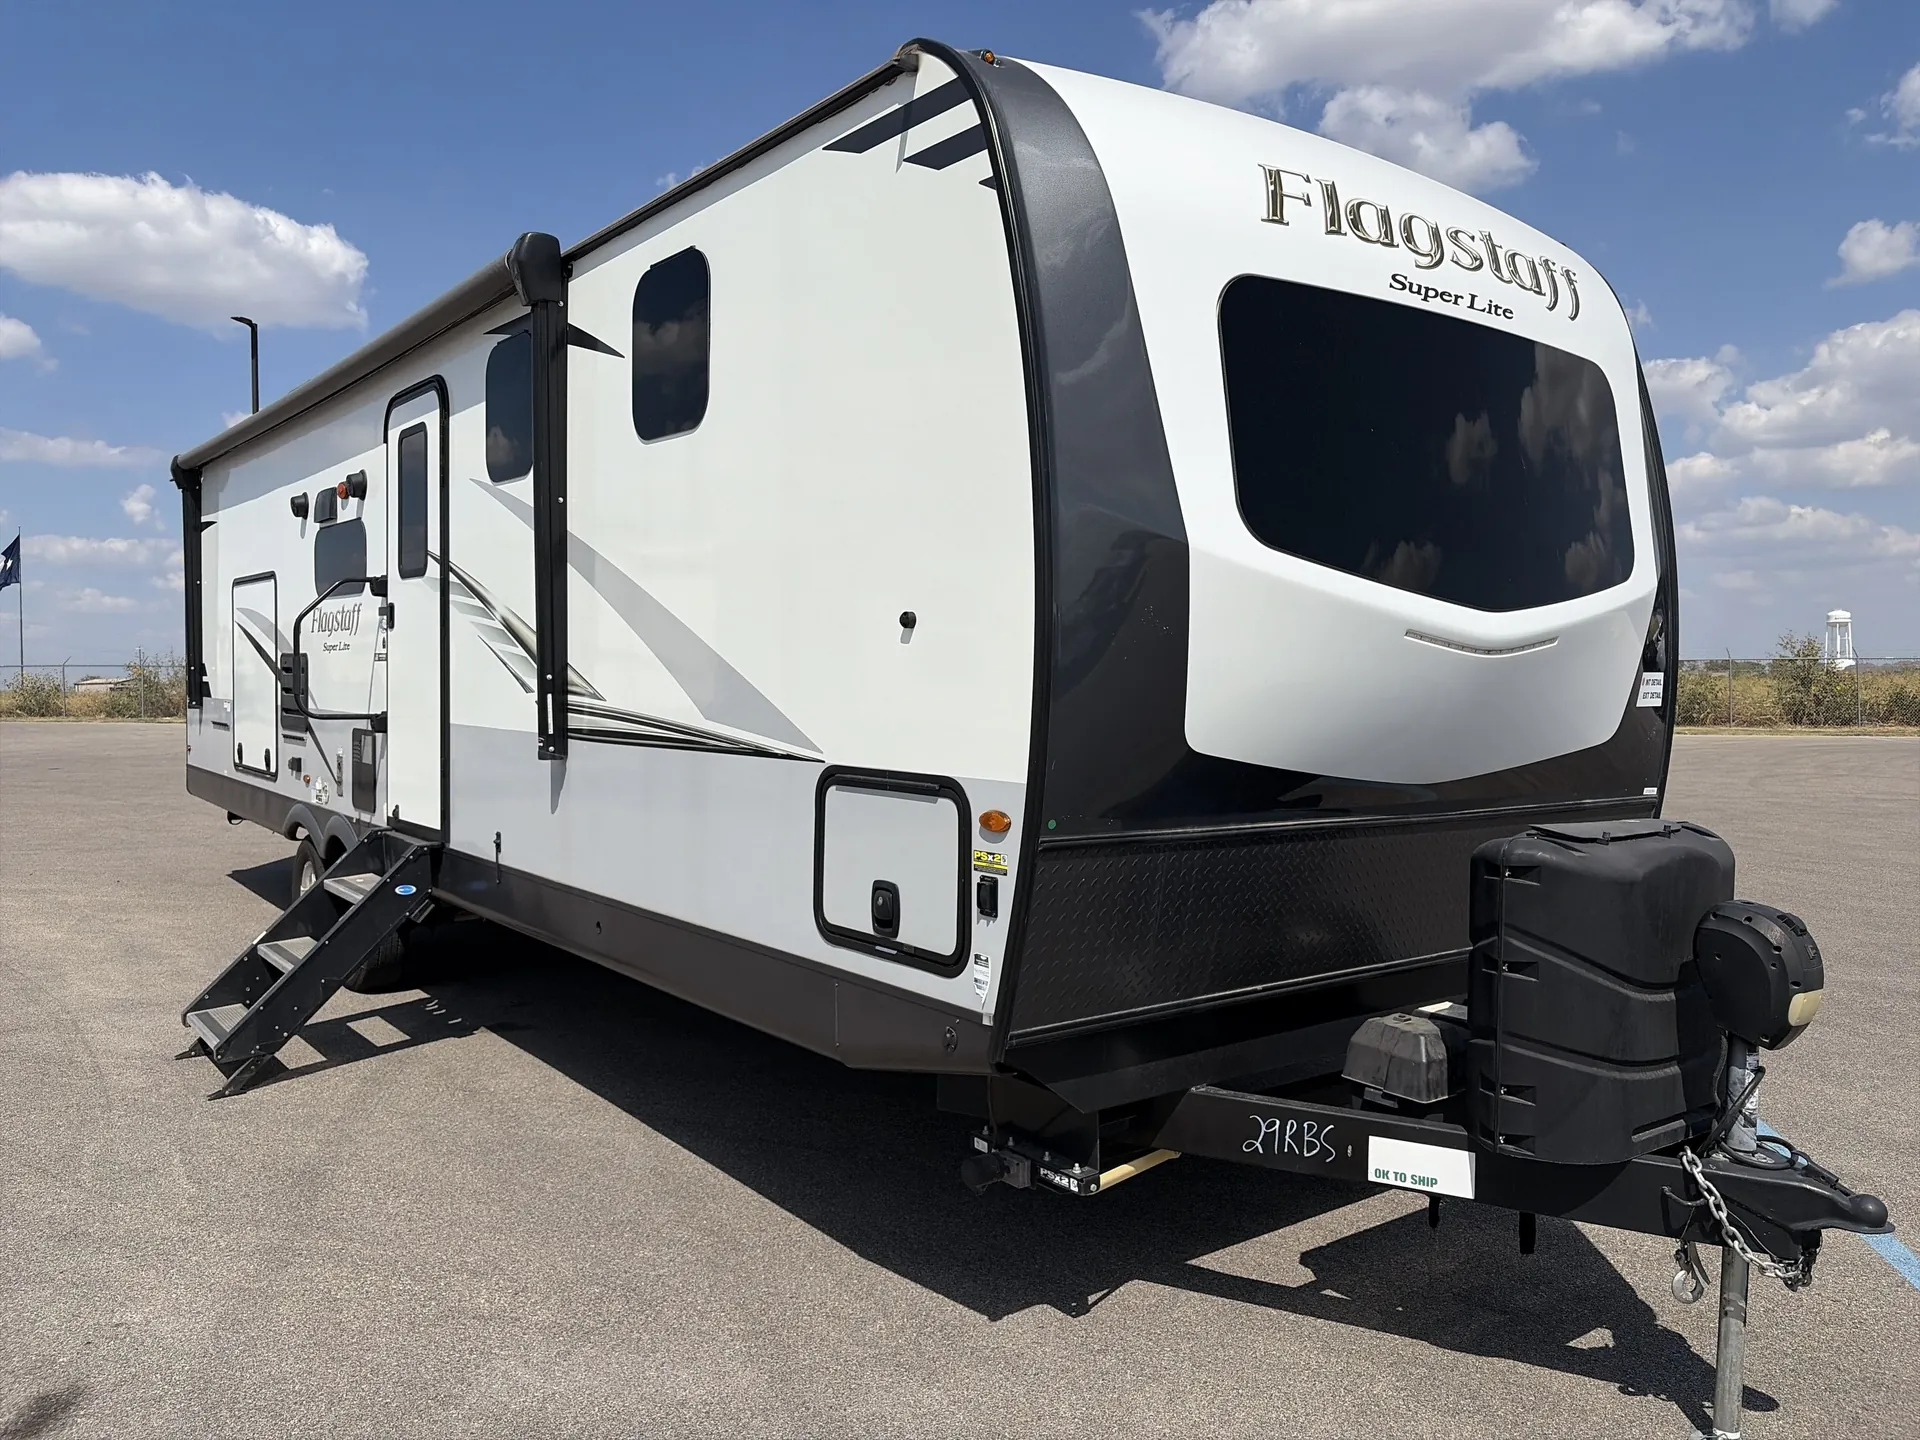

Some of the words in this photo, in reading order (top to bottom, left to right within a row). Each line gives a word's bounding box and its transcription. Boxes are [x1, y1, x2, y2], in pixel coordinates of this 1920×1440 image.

[1258, 162, 1580, 321] Flagstaff
[1389, 273, 1464, 306] Super
[1467, 293, 1514, 319] Lite
[311, 603, 362, 637] Flagstaff
[323, 642, 338, 654] Super
[338, 642, 350, 651] Lite
[1642, 691, 1650, 699] EXT
[1650, 691, 1661, 699] DETAIL
[1242, 1115, 1336, 1163] 29RBS
[1374, 1168, 1390, 1180] OK
[1393, 1171, 1407, 1183] TO
[1410, 1174, 1438, 1188] SHIP
